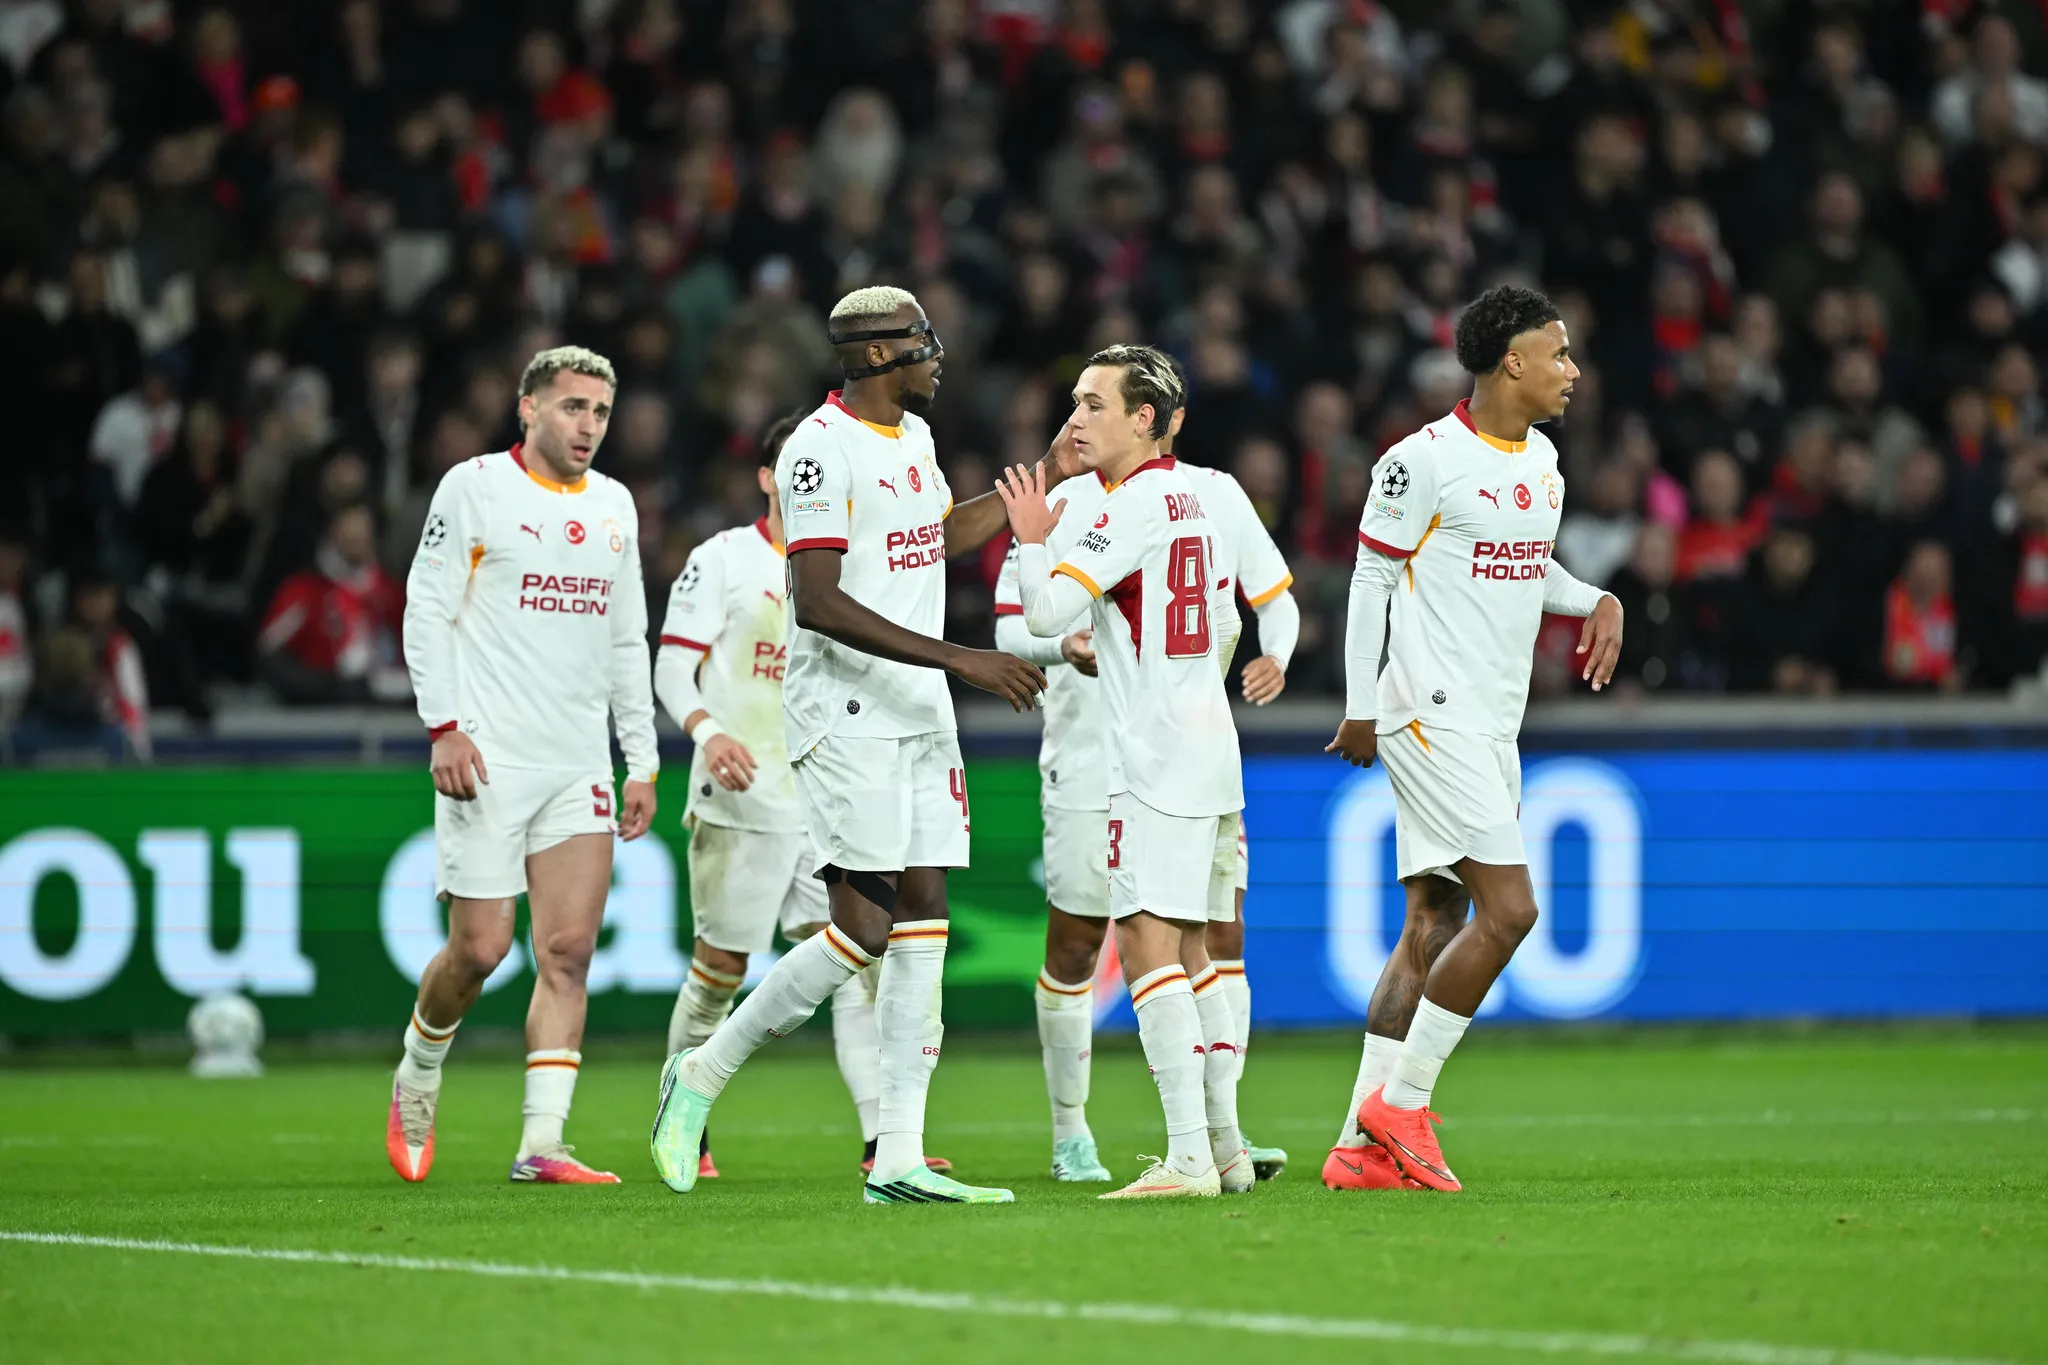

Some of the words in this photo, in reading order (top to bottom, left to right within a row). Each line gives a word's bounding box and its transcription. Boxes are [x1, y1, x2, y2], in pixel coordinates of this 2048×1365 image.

[1078, 538, 1106, 553] INES
[1085, 530, 1111, 547] KISH
[1165, 535, 1214, 660] 8
[591, 783, 611, 817] 5
[949, 767, 969, 818] 4
[1103, 819, 1123, 869] 3
[922, 1046, 940, 1057] GS
